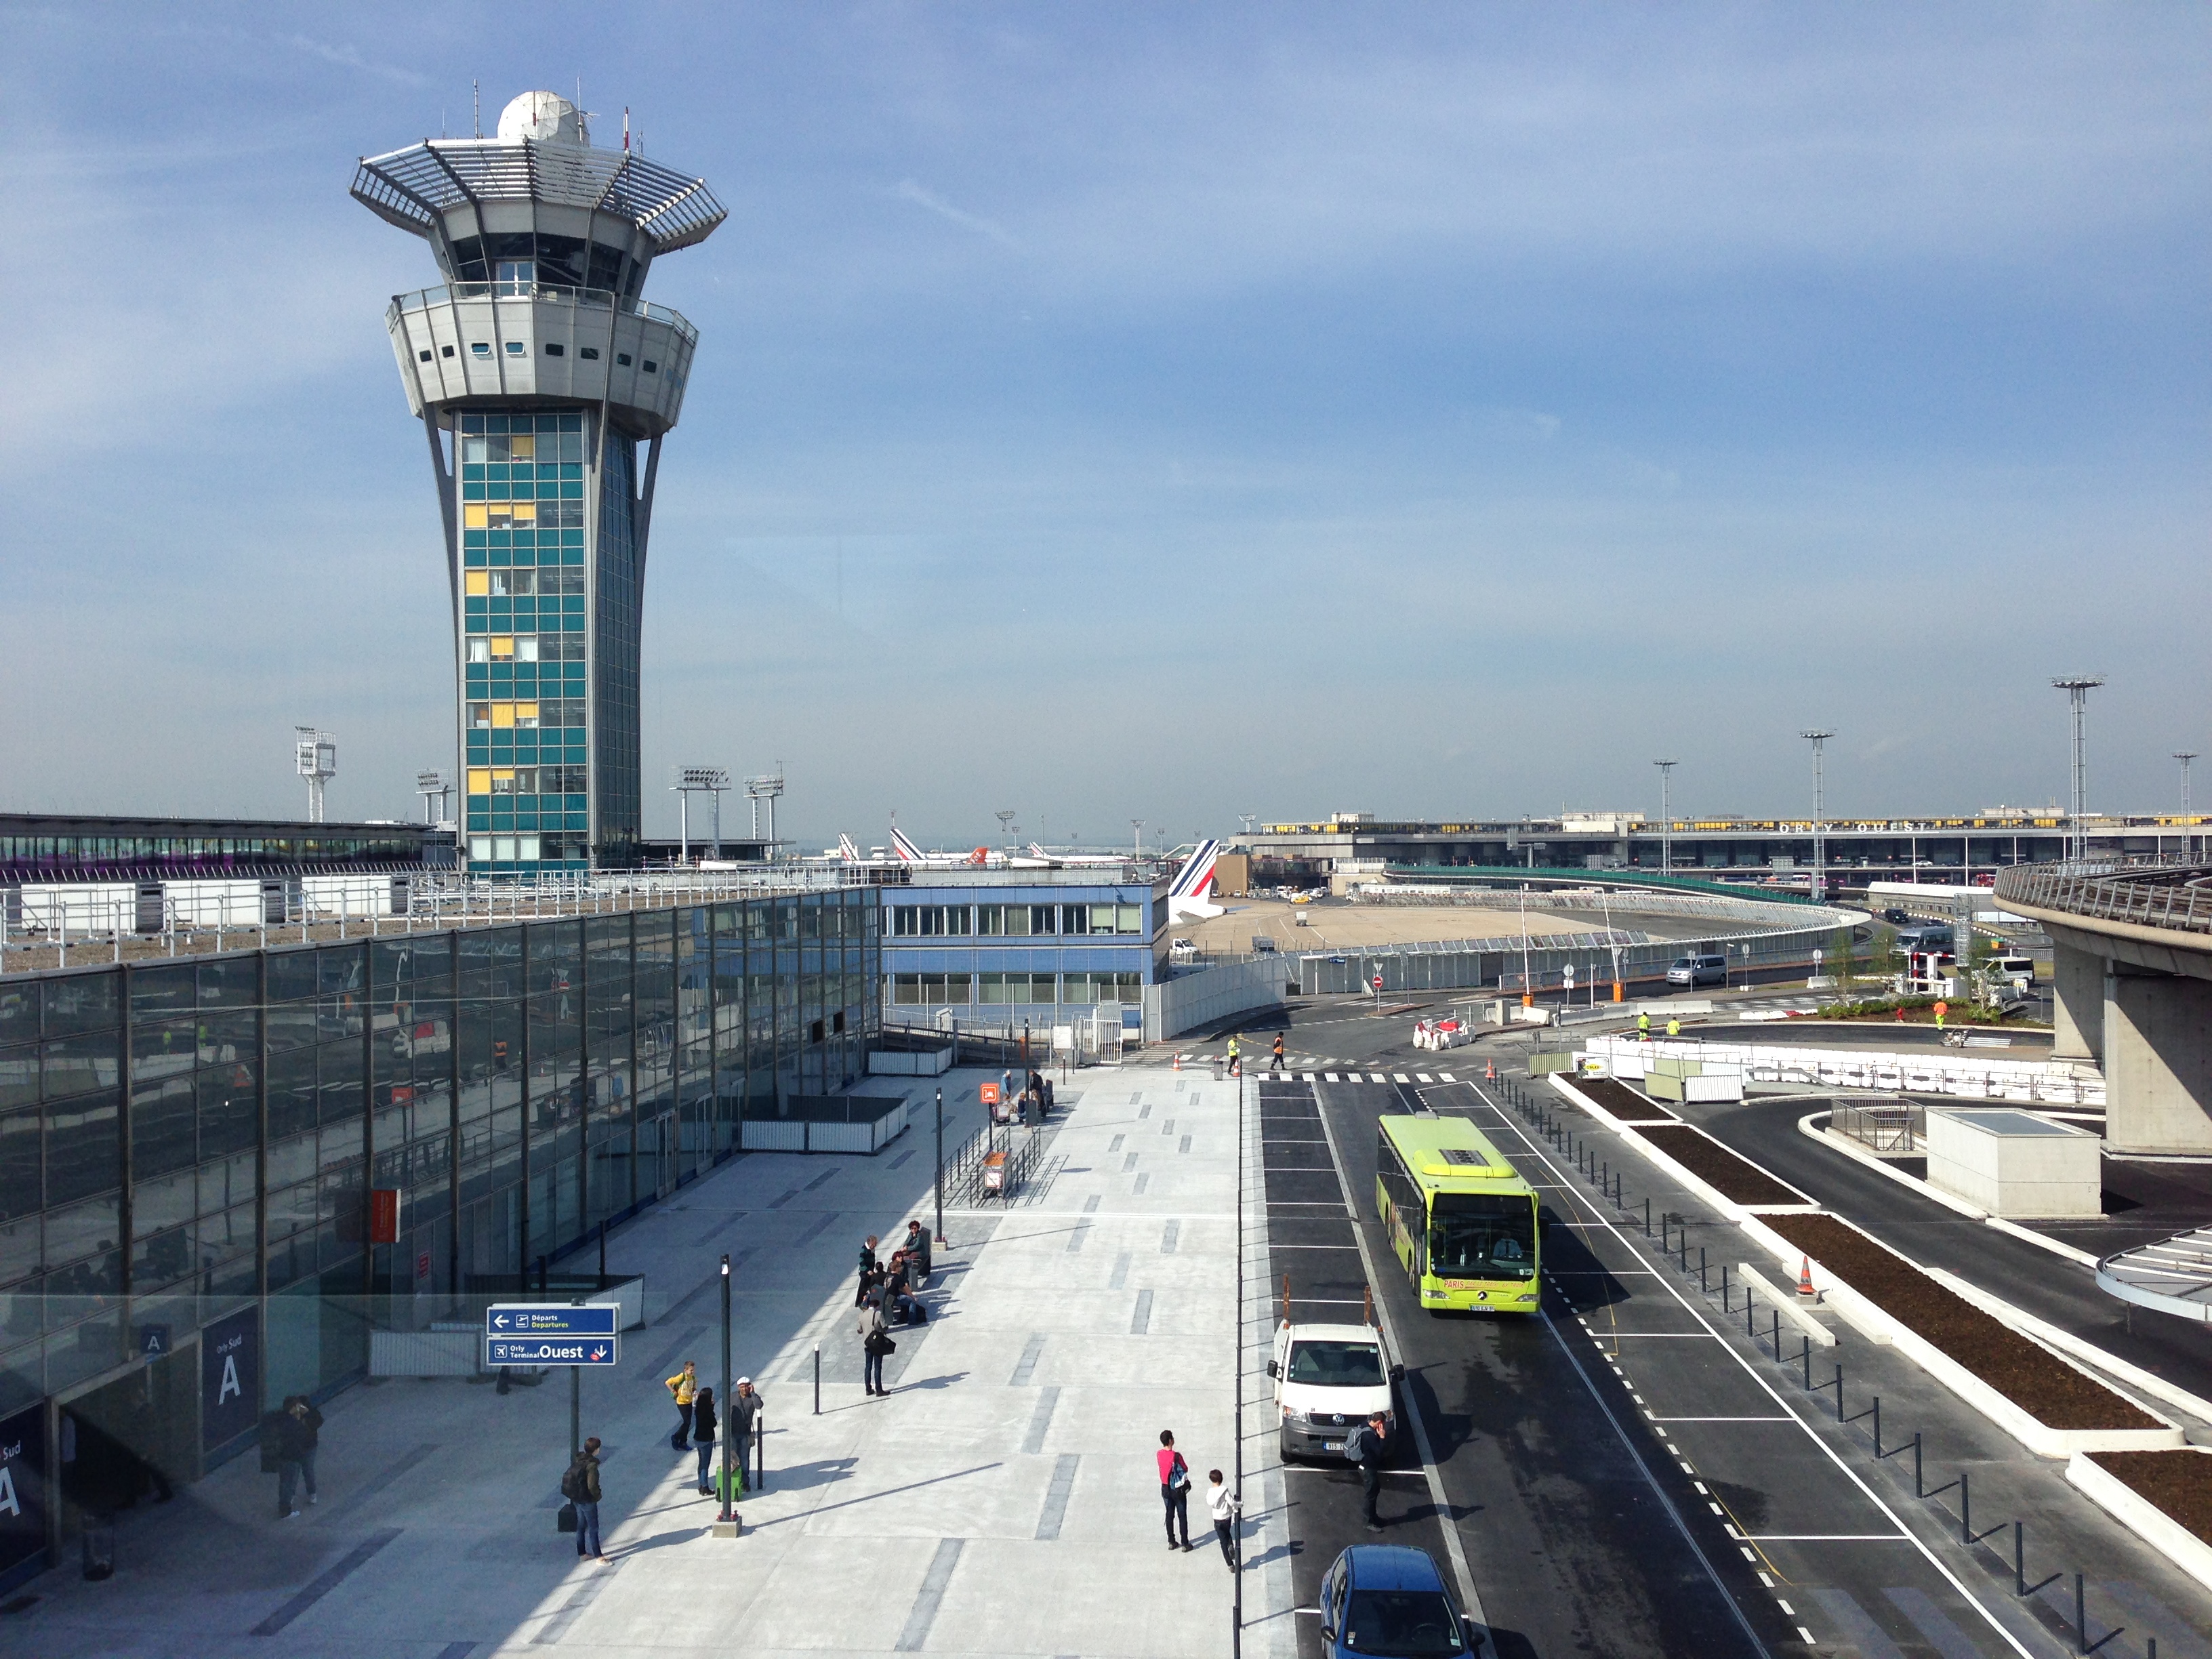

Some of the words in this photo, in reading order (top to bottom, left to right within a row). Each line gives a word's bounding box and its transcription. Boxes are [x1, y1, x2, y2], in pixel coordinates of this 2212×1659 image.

[1858, 823, 1927, 834] OUEST
[1444, 1280, 1465, 1289] PARIS
[148, 1336, 160, 1350] A
[228, 1333, 242, 1350] Sud
[539, 1345, 583, 1359] Ouest
[218, 1355, 241, 1405] A
[3, 1440, 21, 1460] Sud
[0, 1467, 20, 1516] A
